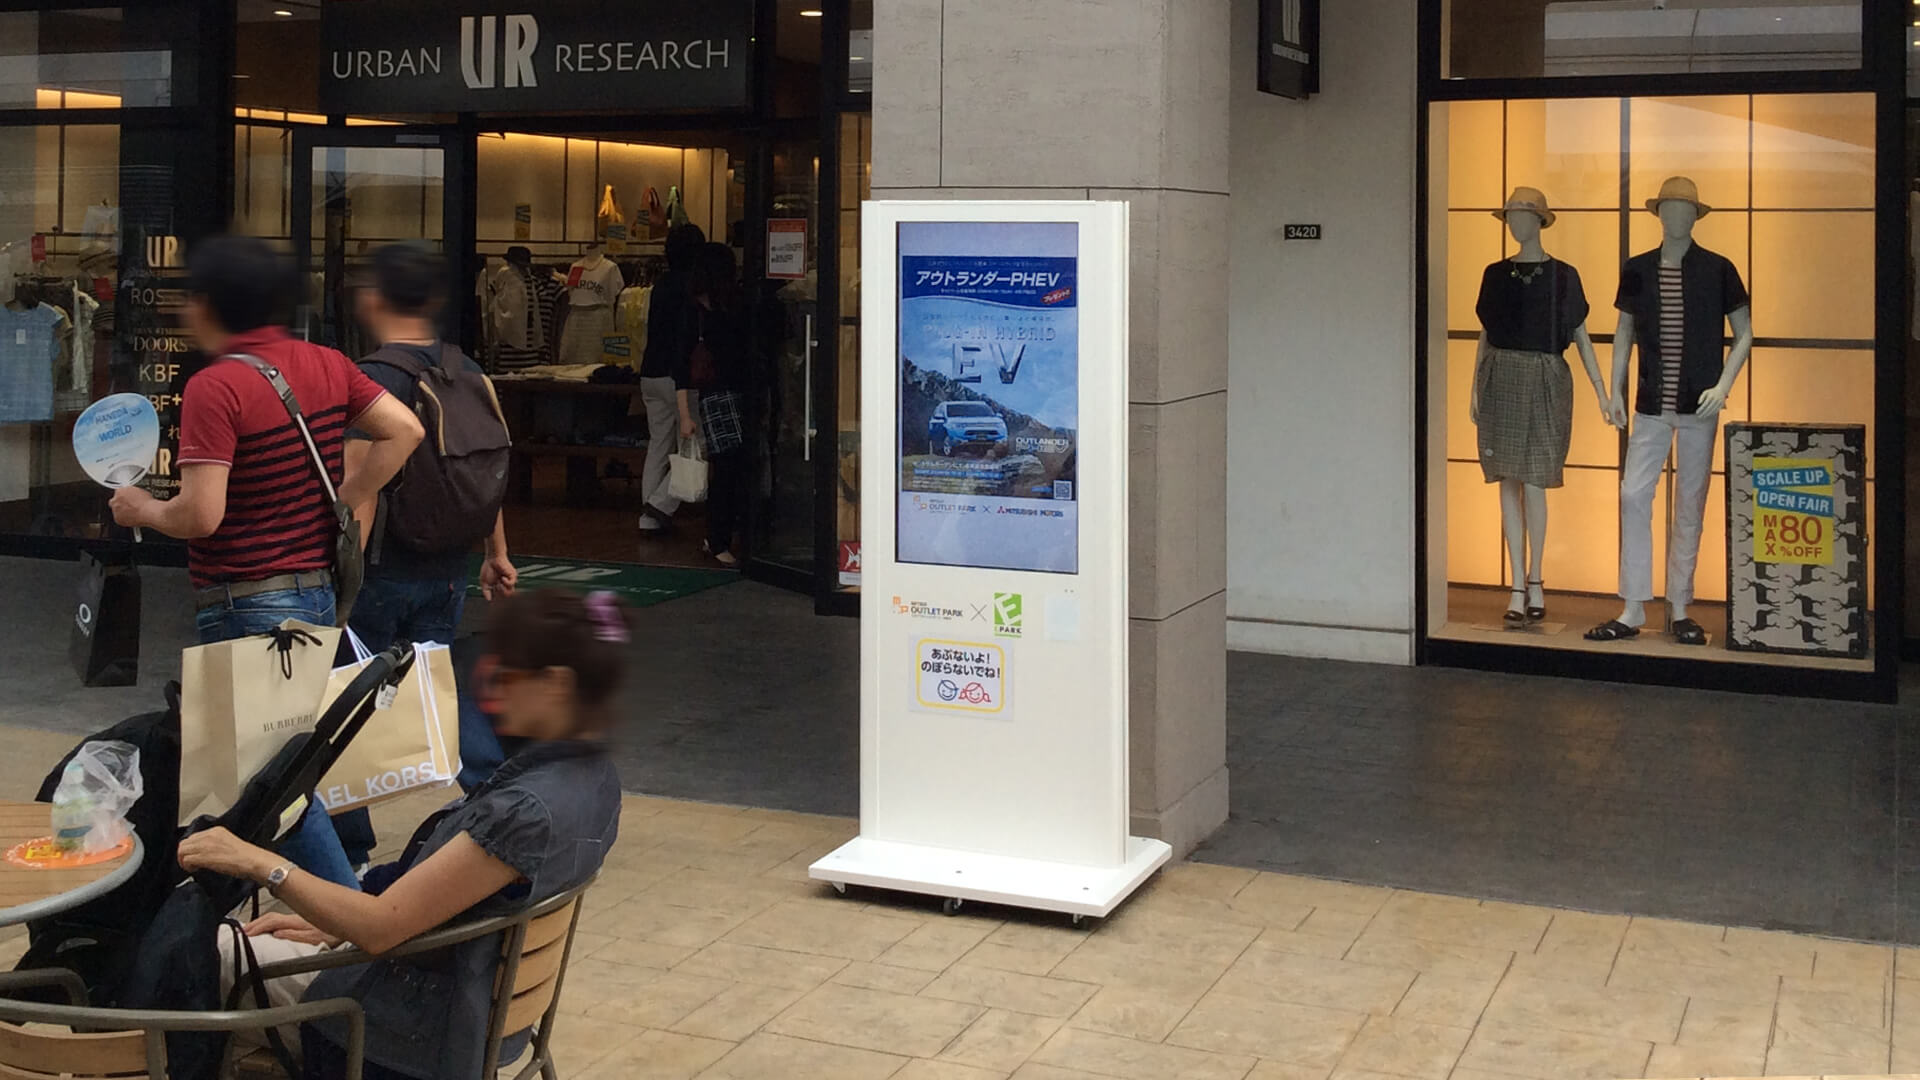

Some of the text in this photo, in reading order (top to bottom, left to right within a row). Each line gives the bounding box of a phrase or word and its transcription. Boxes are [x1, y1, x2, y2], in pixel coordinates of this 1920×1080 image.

[332, 14, 729, 89] URBAN UR RESEARCH
[1288, 226, 1317, 238] 3420
[916, 271, 1061, 287] アウトランダーPHEV
[952, 343, 1027, 384] EV
[138, 364, 181, 383] KBF
[98, 424, 132, 442] WORLD
[1757, 470, 1824, 486] SCALE UP
[1759, 491, 1829, 513] OPEN FAIR
[1763, 515, 1777, 556] MAX
[1779, 515, 1823, 545] 80
[1780, 546, 1823, 558] %OFF
[911, 606, 963, 617] OUTLET PARK
[931, 648, 990, 664] あぶないよ!
[921, 661, 1001, 679] のぼらないでね!
[365, 761, 435, 798] KORS
